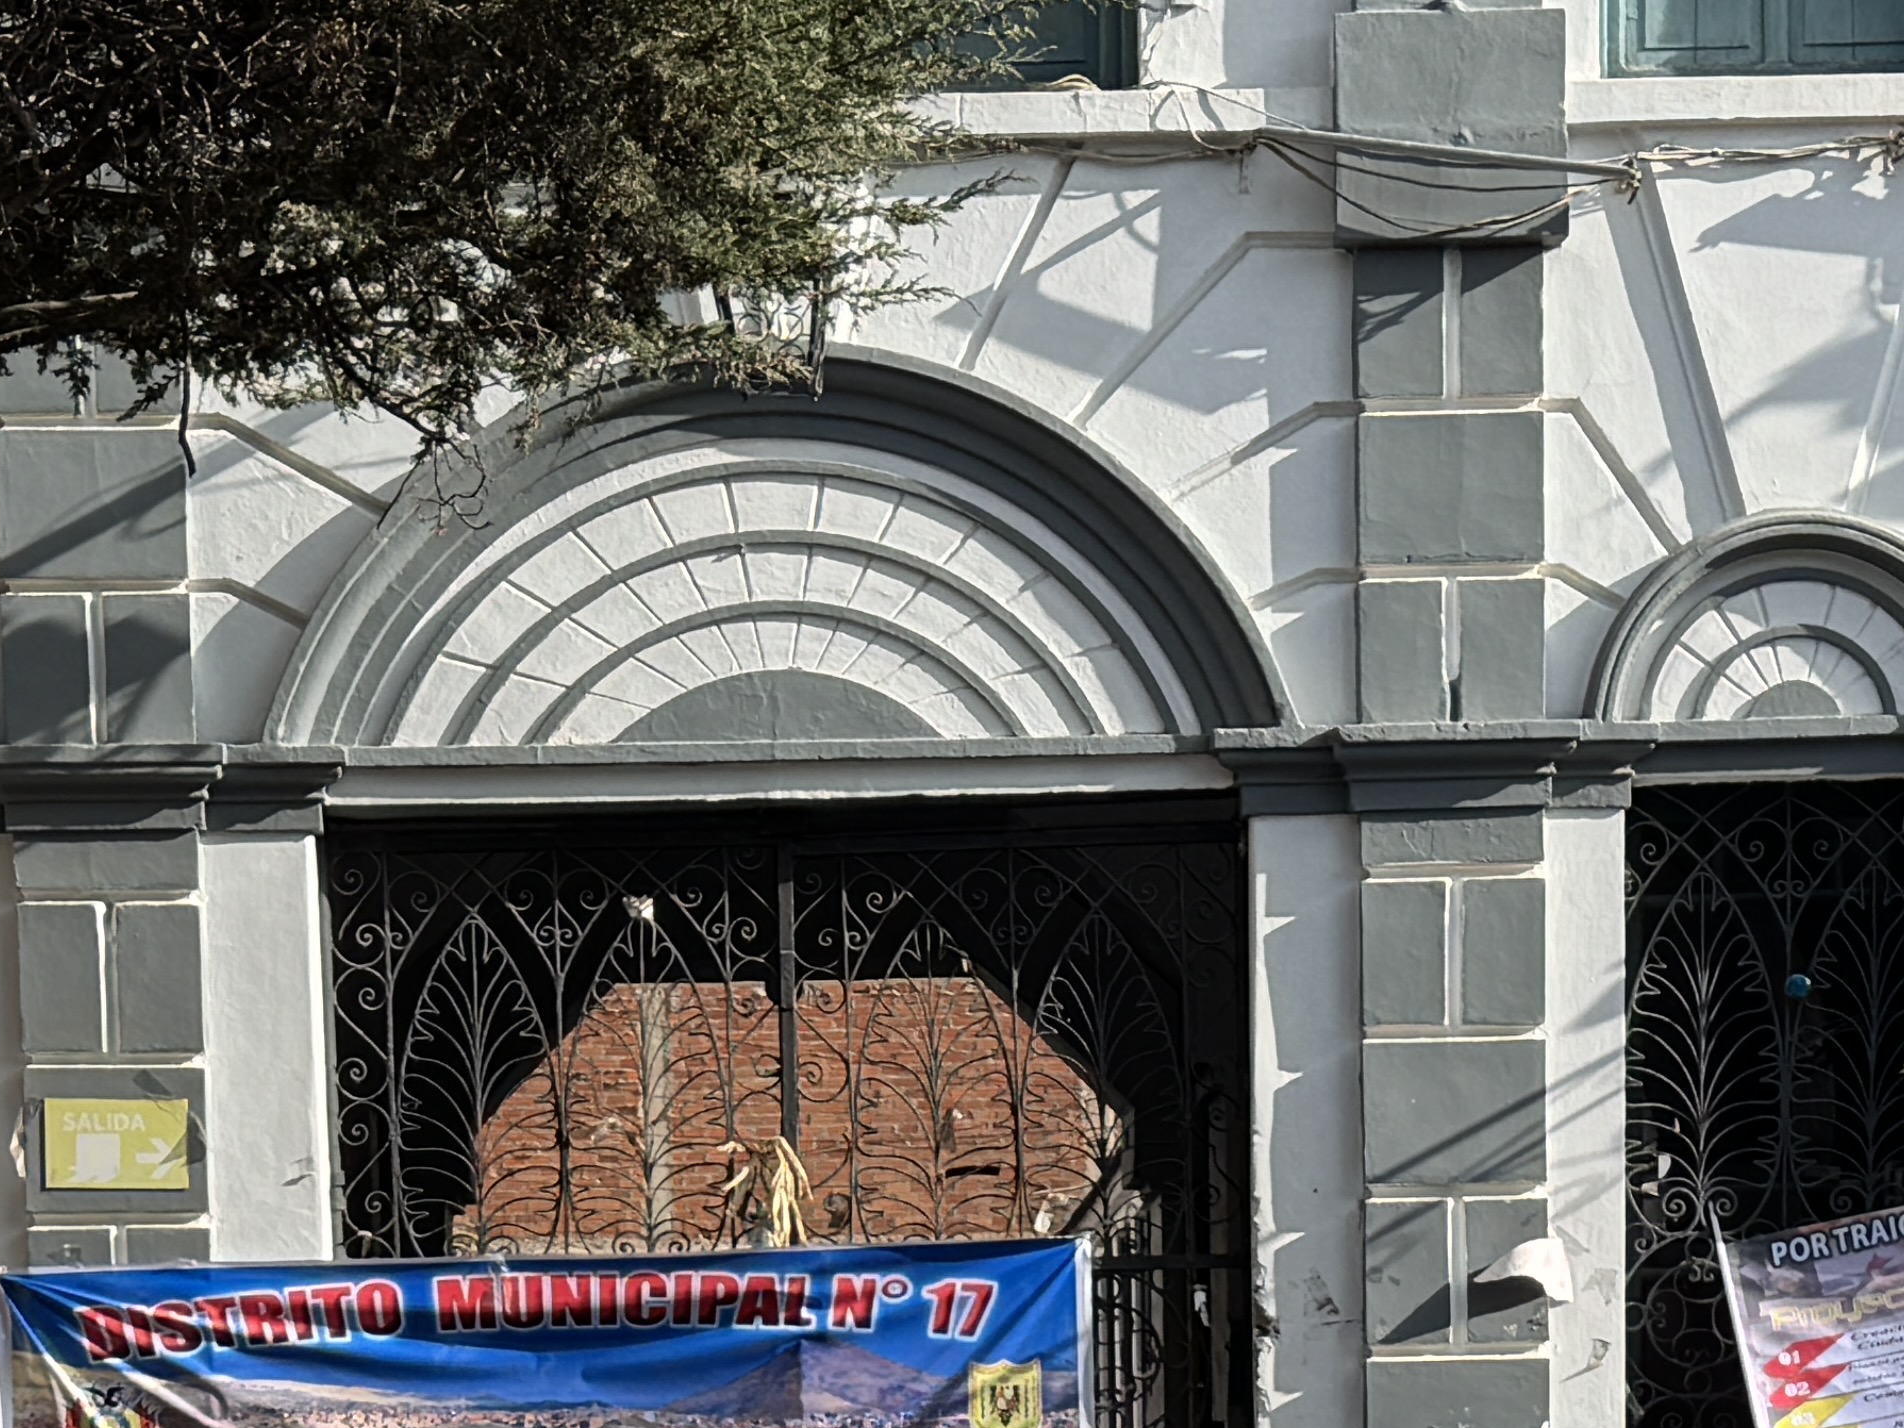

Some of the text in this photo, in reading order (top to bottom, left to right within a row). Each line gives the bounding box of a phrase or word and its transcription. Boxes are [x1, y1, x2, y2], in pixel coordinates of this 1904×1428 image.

[62, 1112, 146, 1132] SALIDA
[1769, 1237, 1830, 1268] POR
[73, 1278, 404, 1364] DISTRITO
[432, 1271, 816, 1334] MUNICIPAL
[925, 1277, 997, 1341] 17
[1778, 1350, 1802, 1366] 01
[1784, 1381, 1810, 1397] 02
